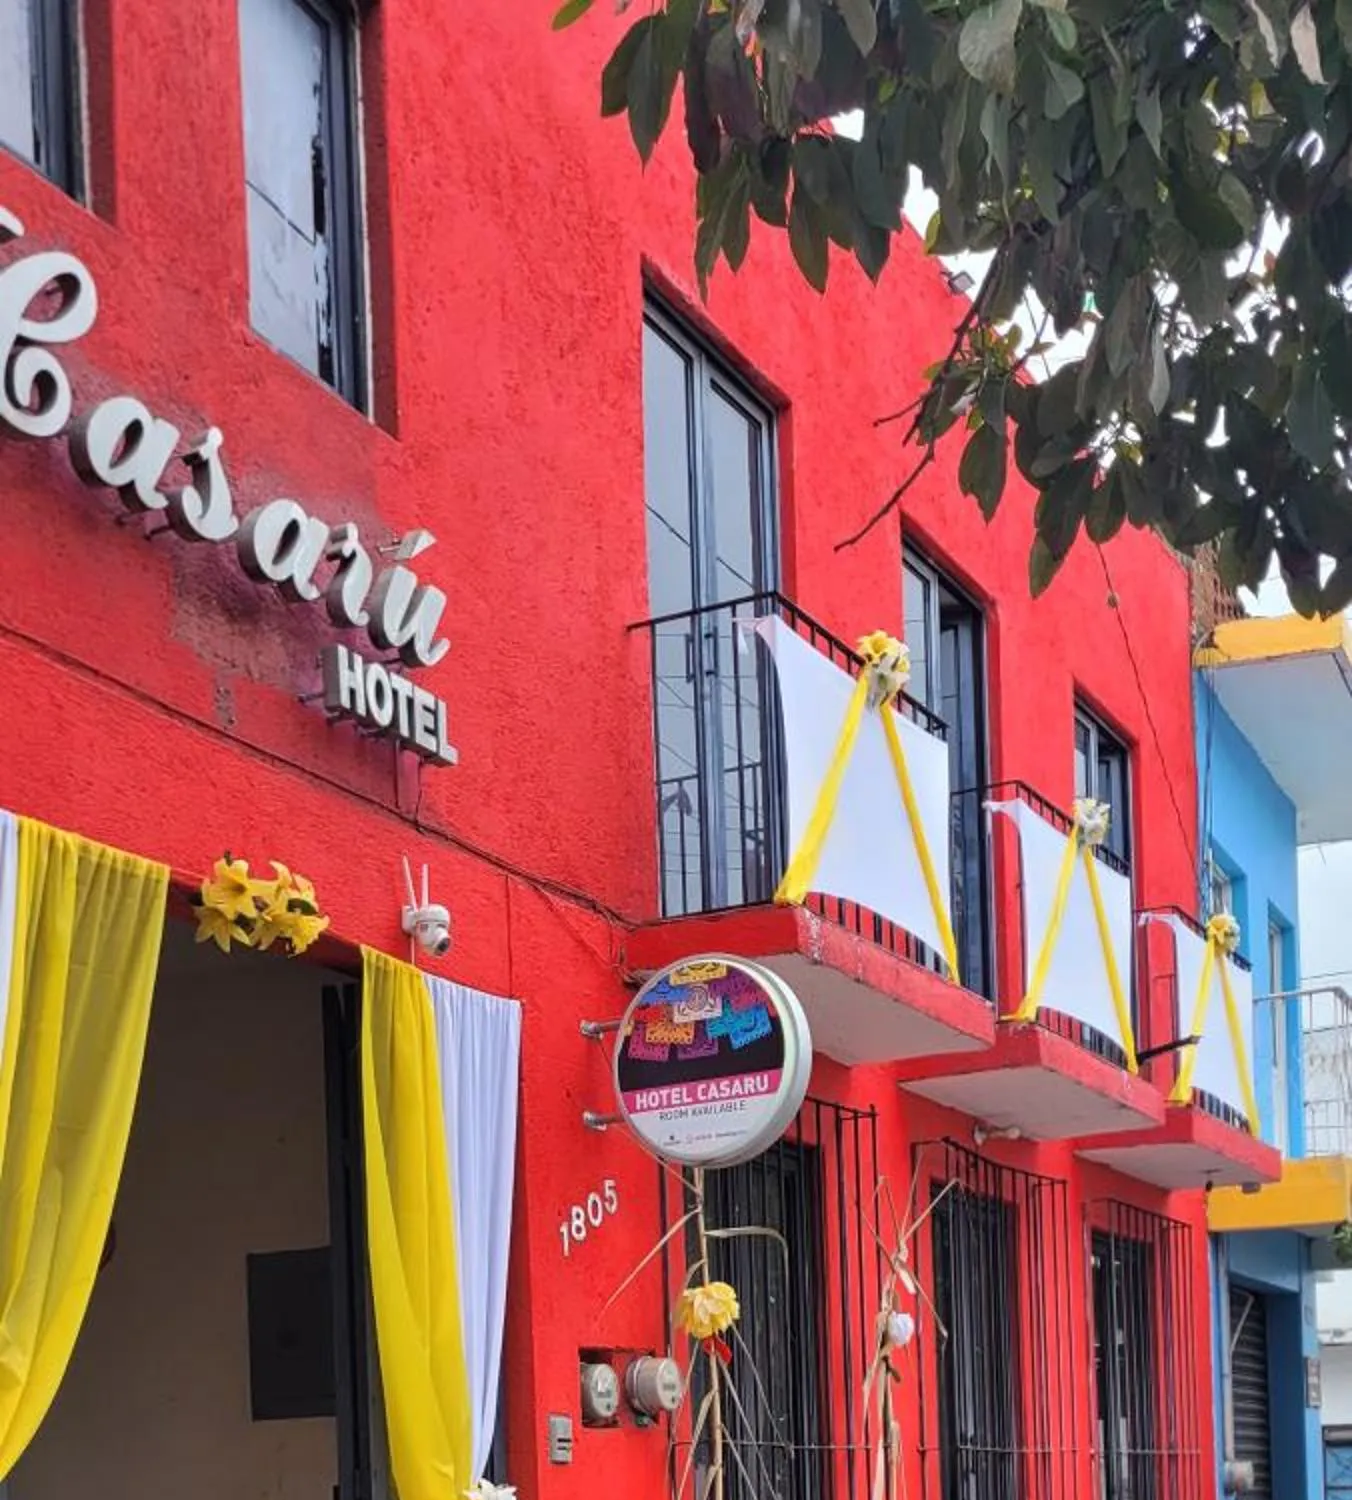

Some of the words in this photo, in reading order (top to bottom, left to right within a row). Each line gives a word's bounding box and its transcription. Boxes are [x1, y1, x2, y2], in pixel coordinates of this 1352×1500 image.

[334, 646, 458, 766] HOTEL
[635, 1087, 693, 1109] HOTEL
[697, 1074, 769, 1101] CASARU
[659, 1109, 690, 1121] ROOM
[691, 1100, 747, 1117] AVAILABLE
[560, 1179, 618, 1256] 1805
